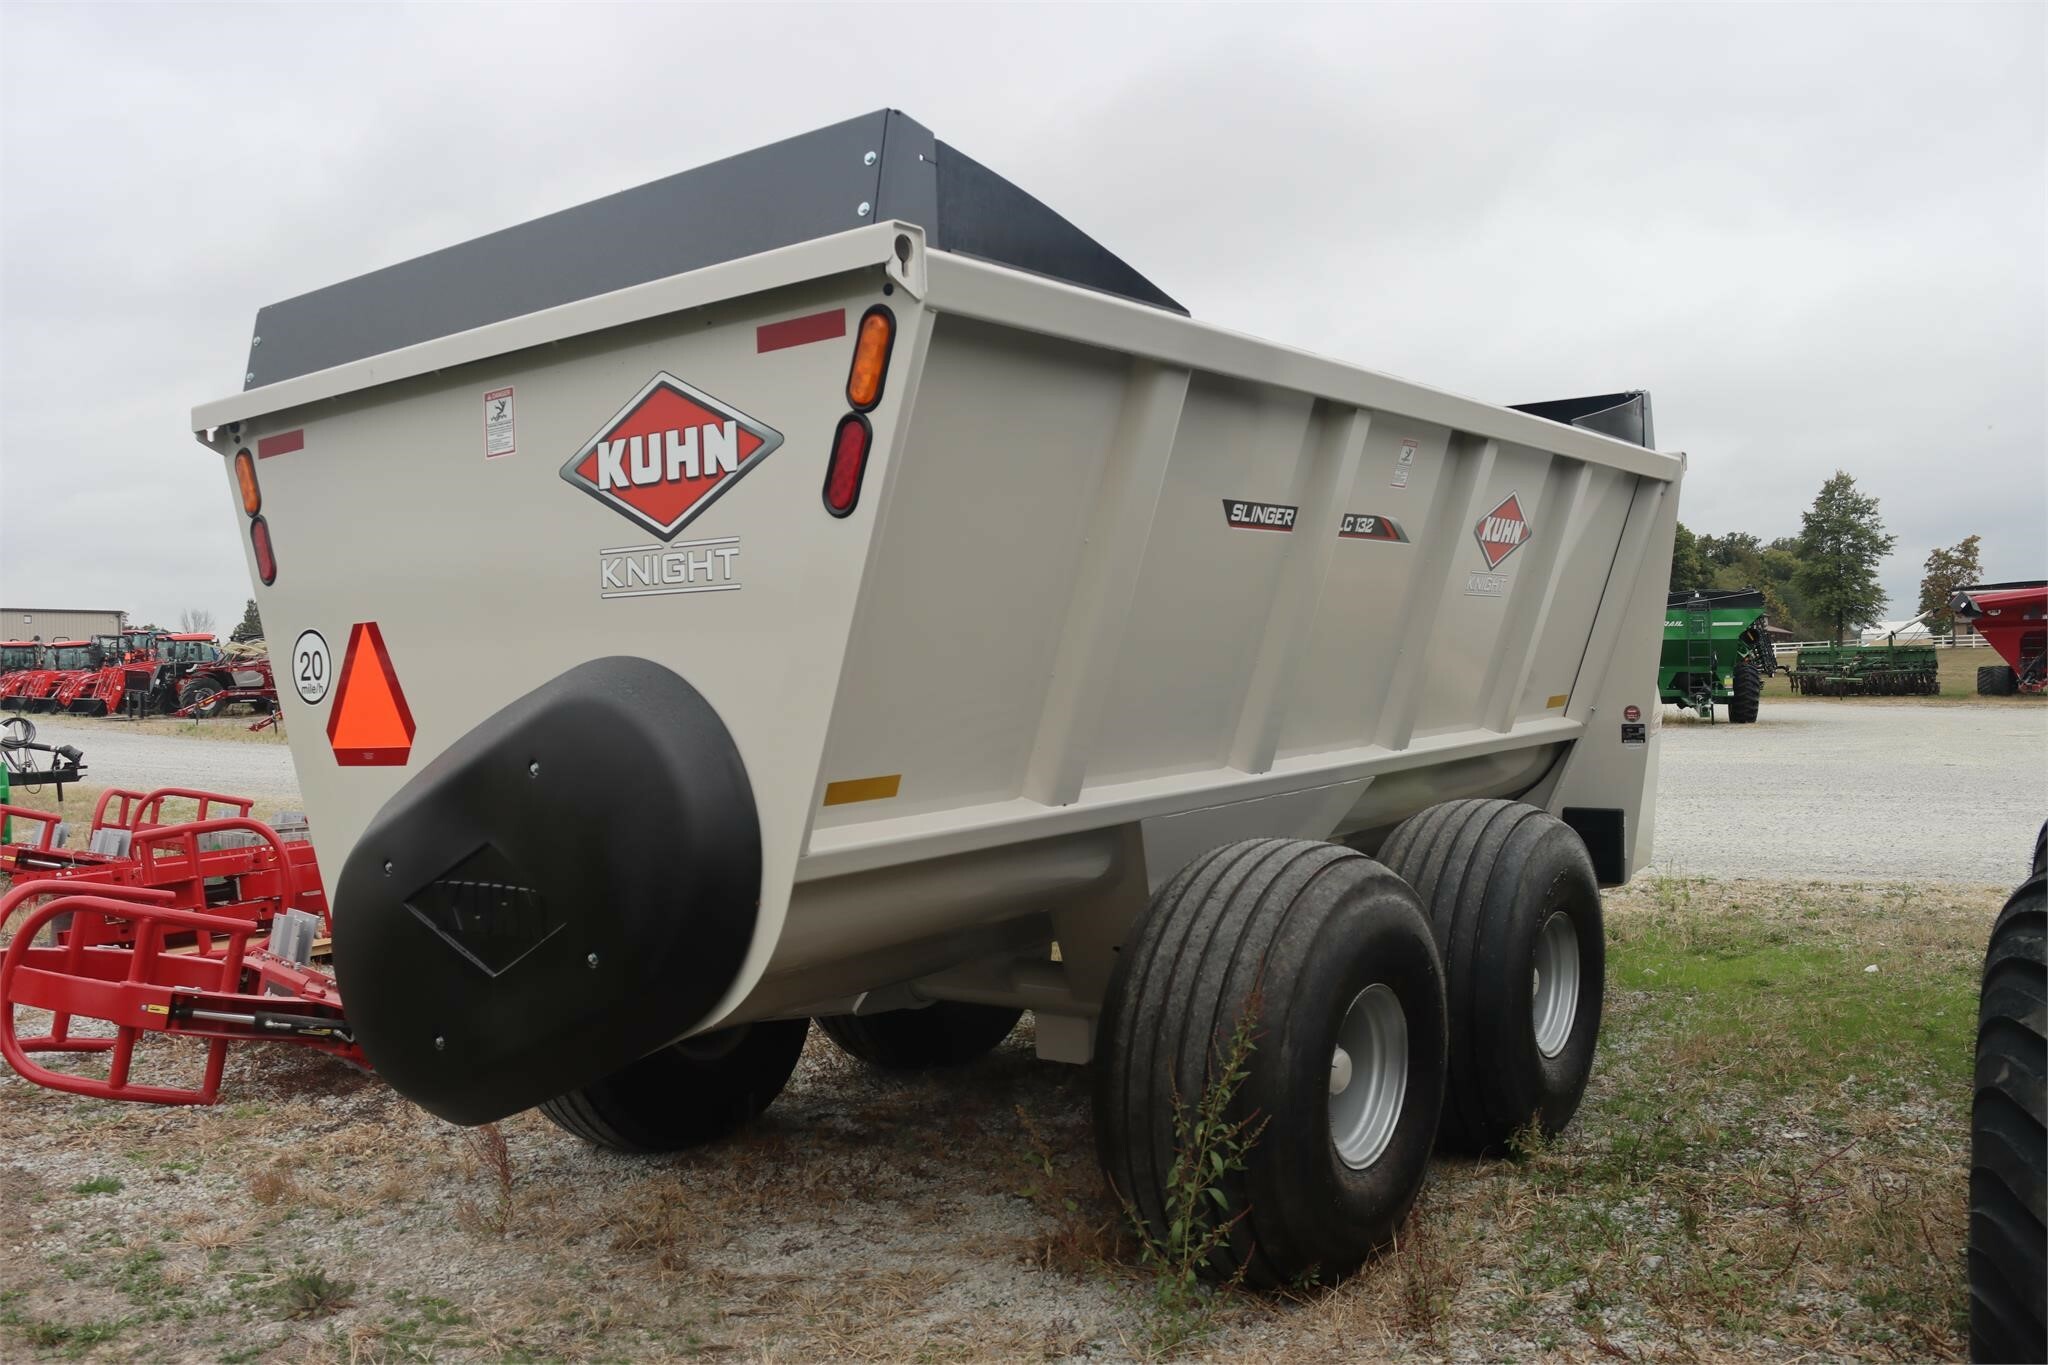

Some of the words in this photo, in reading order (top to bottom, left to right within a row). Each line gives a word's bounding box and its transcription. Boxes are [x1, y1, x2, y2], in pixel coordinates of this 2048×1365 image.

[597, 420, 738, 490] KUHN
[1230, 503, 1295, 526] SLINGER
[1355, 517, 1375, 533] 132
[1481, 516, 1524, 544] KUHN
[601, 547, 740, 589] KNIGHT
[1464, 574, 1508, 592] KNIGHT
[300, 651, 323, 681] 20
